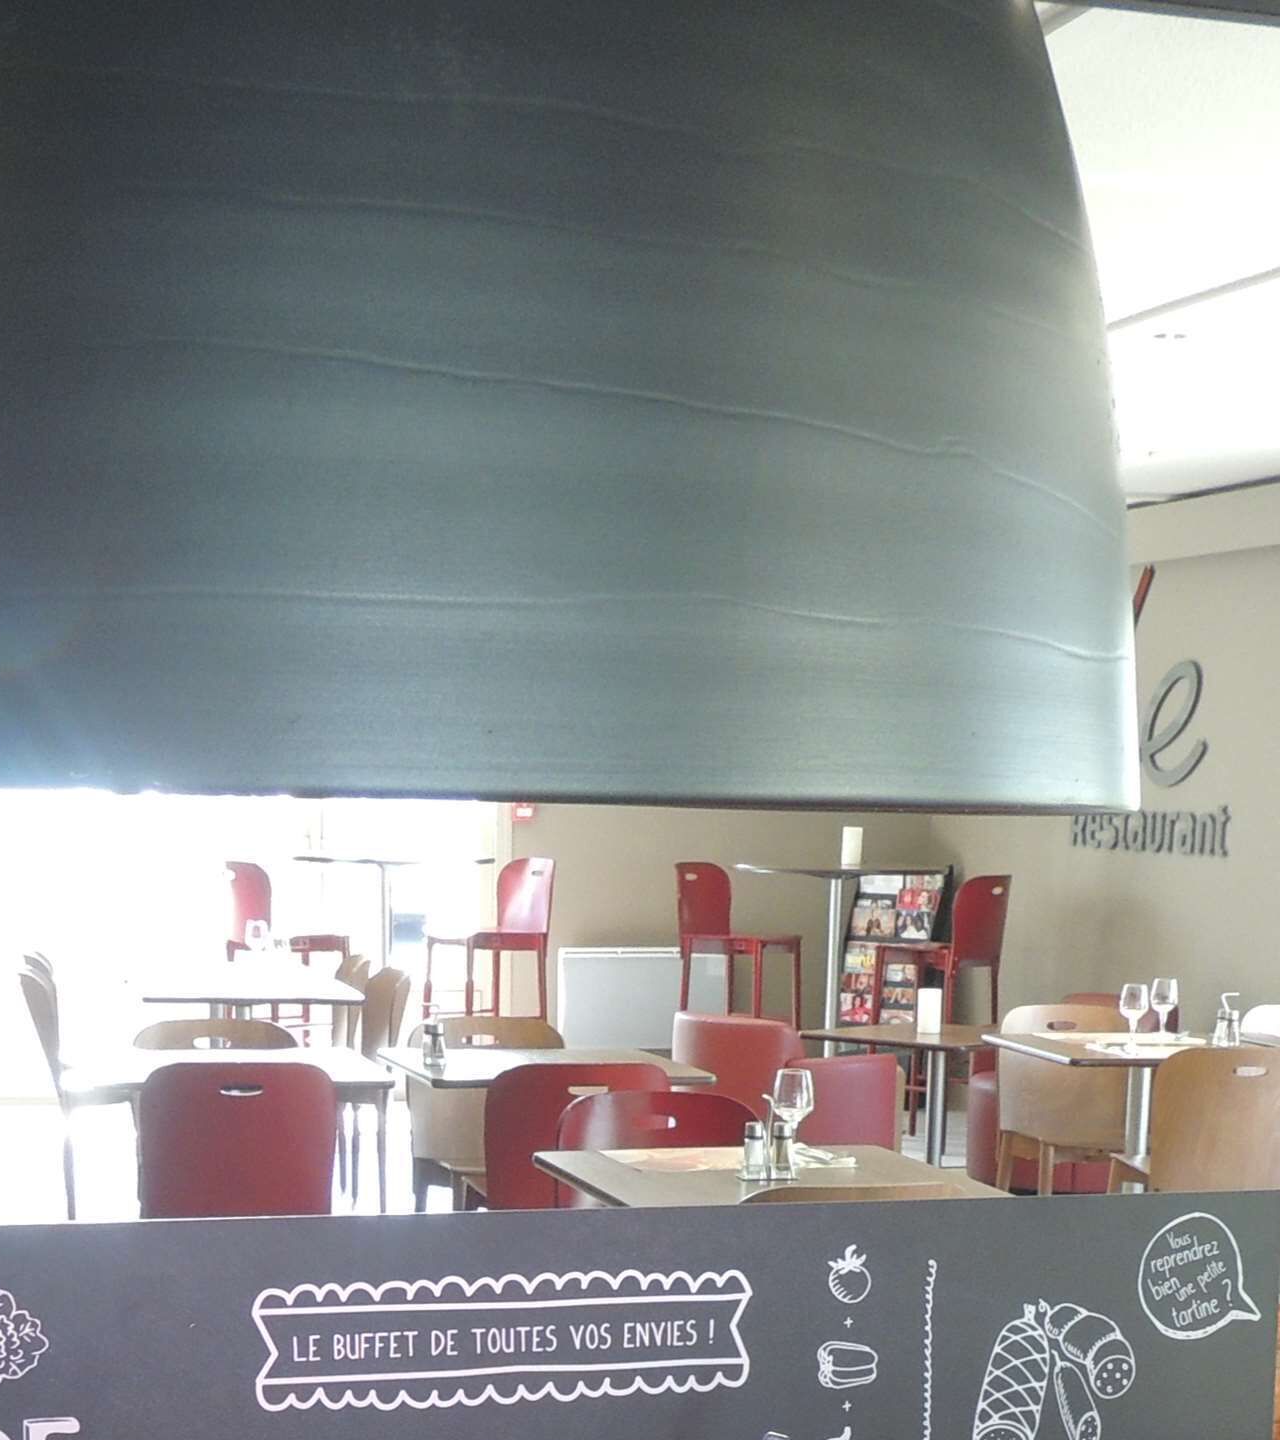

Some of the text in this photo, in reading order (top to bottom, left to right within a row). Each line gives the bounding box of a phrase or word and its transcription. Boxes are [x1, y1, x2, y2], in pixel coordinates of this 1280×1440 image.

[1150, 1235, 1220, 1278] reprendrez
[1165, 1231, 1192, 1249] Vous
[1147, 1260, 1227, 1302] bien une petite
[1171, 1298, 1221, 1328] tartine
[292, 1335, 321, 1362] LE
[332, 1330, 419, 1361] BUFFET
[430, 1328, 459, 1356] DE
[471, 1324, 558, 1355] TOUTES
[569, 1323, 612, 1350] VOS
[622, 1319, 698, 1348] ENVIES
